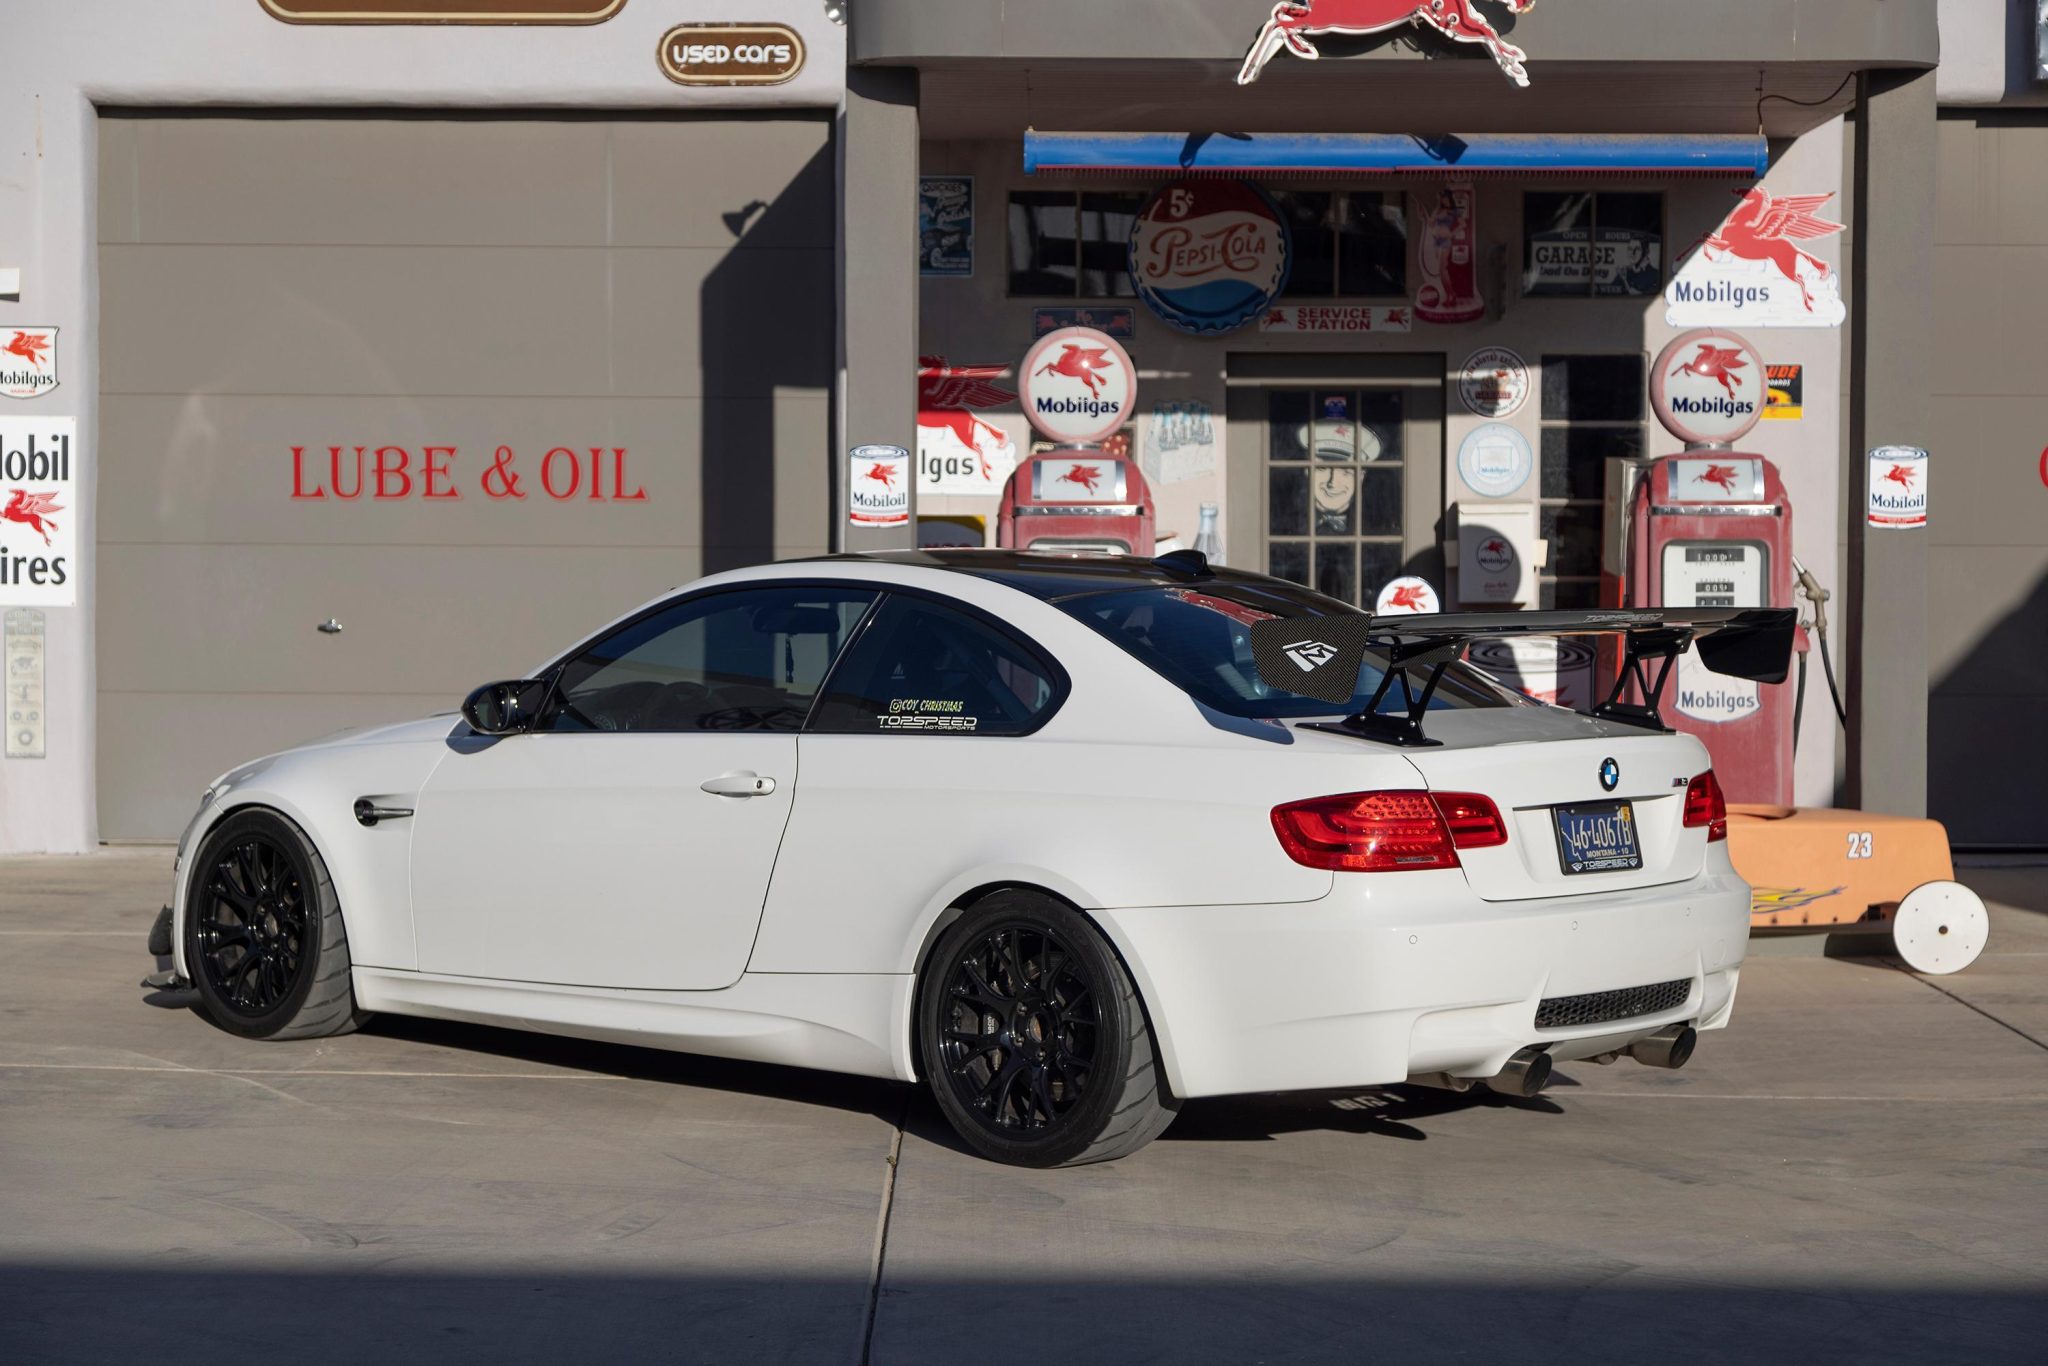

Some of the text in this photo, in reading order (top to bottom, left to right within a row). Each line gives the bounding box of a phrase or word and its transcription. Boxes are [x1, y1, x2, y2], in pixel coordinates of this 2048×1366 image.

[673, 45, 730, 63] USED
[1535, 246, 1616, 265] GARAGE
[1675, 281, 1770, 308] Mobilgas
[1297, 307, 1372, 319] SERVICE
[1297, 319, 1372, 331] STATION
[1766, 365, 1800, 380] UDE
[1672, 396, 1754, 418] Mobilgas
[0, 434, 70, 481] obil
[921, 448, 974, 483] lgas
[290, 444, 648, 501] LUBE & OIL
[852, 491, 906, 508] Mobiloil
[1871, 492, 1925, 509] Mobiloil
[0, 546, 67, 585] ires
[1681, 691, 1755, 713] Mobilgas
[876, 715, 978, 727] TOPSPEED
[1586, 848, 1617, 858] MONTANA
[1847, 831, 1873, 859] 23
